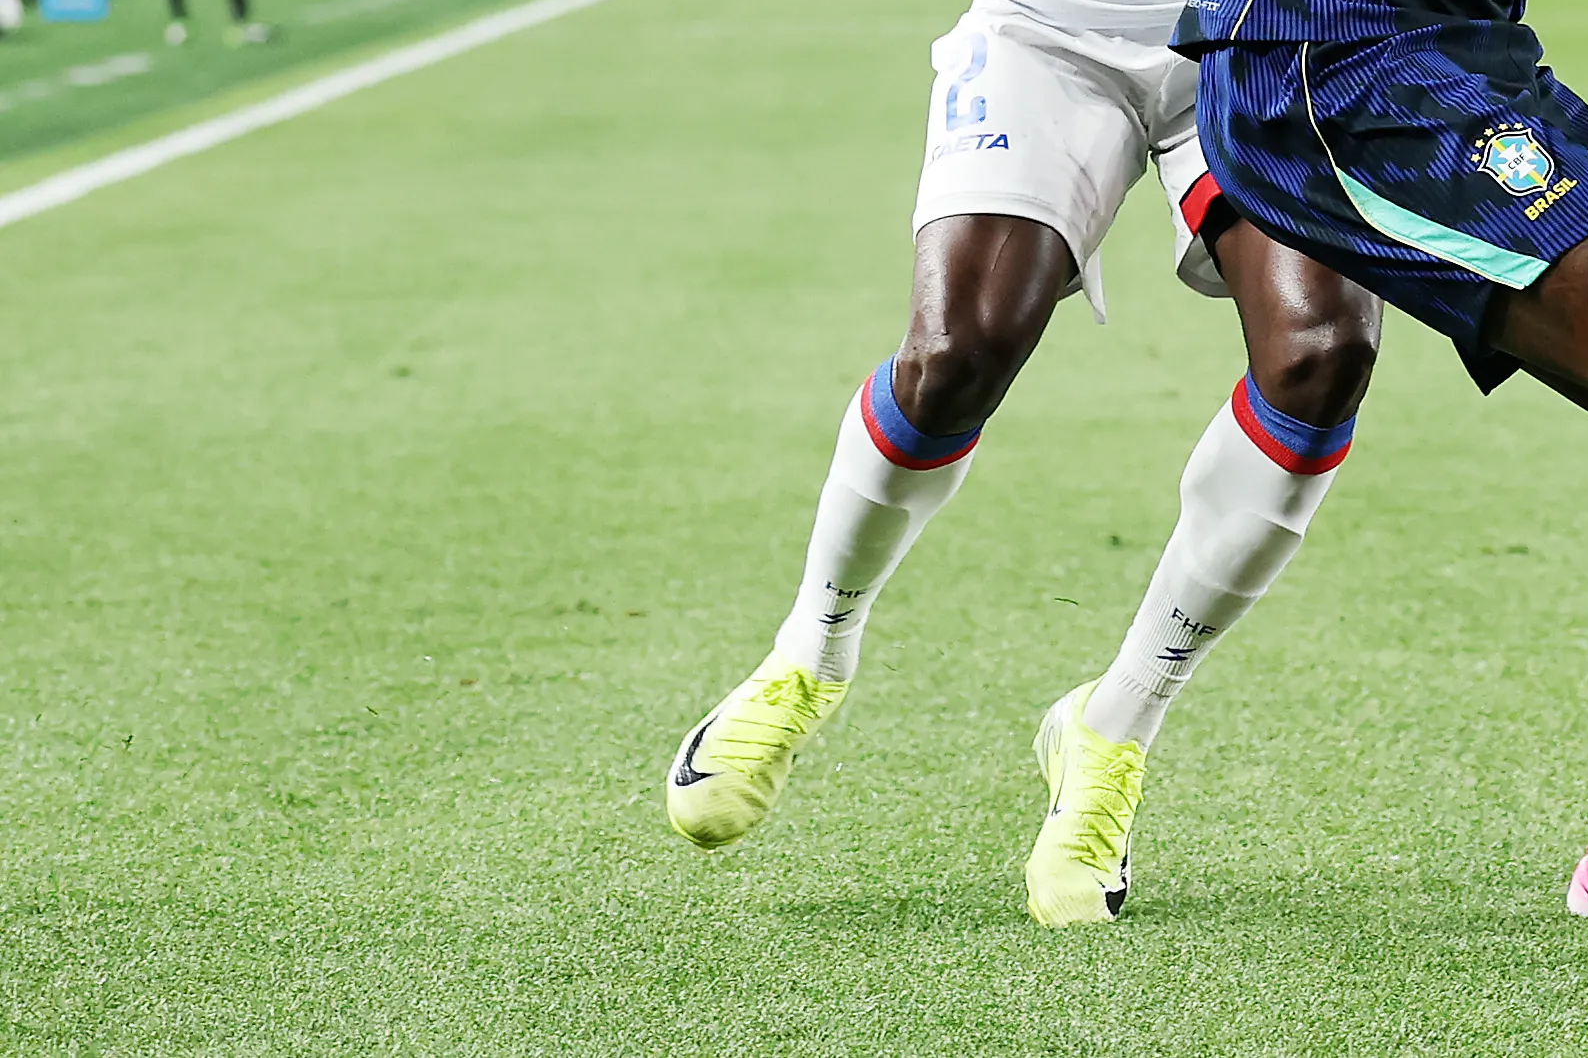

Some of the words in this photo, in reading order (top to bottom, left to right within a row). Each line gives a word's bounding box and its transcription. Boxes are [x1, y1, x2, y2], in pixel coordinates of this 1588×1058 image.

[944, 32, 987, 131] 2
[1507, 153, 1526, 170] CBF
[1524, 177, 1577, 221] BRASIL
[1172, 607, 1216, 636] FHF
